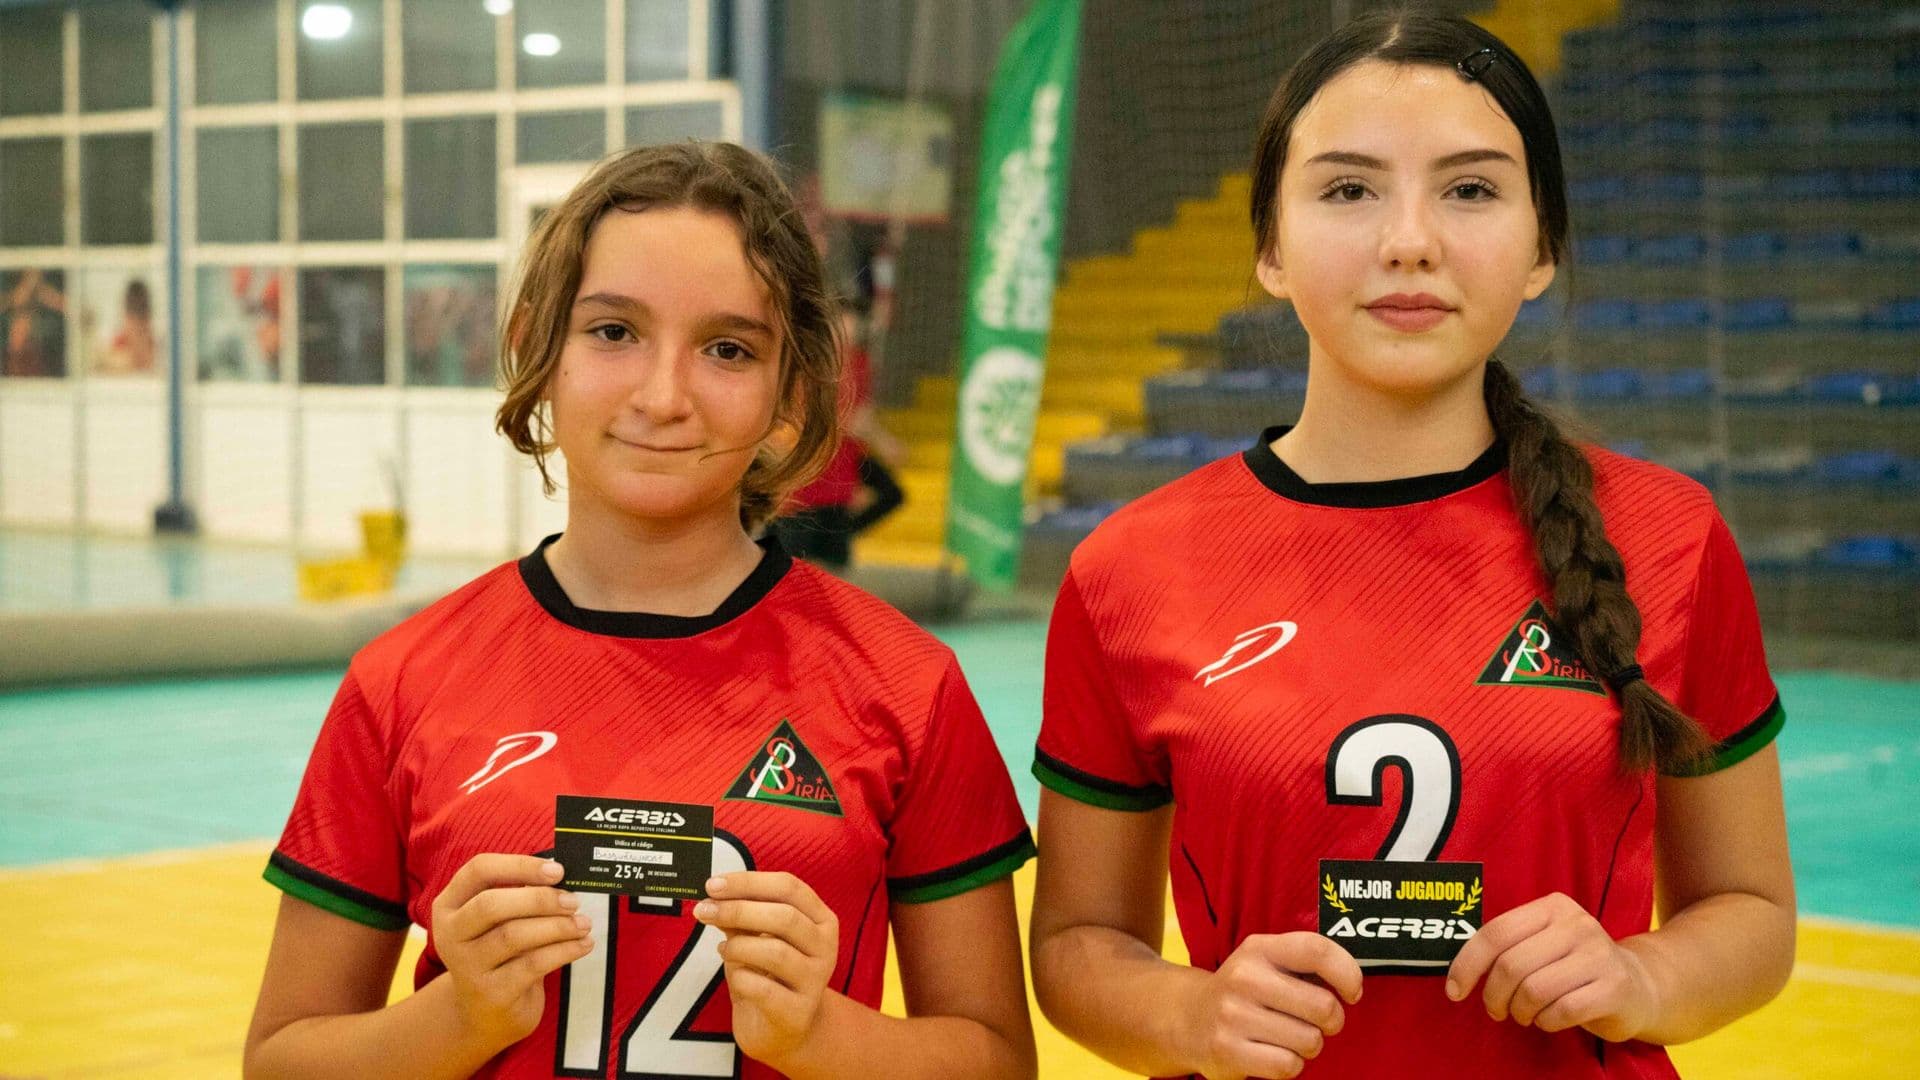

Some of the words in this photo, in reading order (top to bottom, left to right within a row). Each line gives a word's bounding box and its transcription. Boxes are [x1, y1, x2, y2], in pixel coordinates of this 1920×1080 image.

[1325, 713, 1461, 861] 2
[584, 806, 686, 827] ACERBIS
[614, 864, 645, 879] 25%
[1338, 879, 1392, 900] MEJOR
[1396, 881, 1465, 901] JUGADOR
[1326, 916, 1478, 940] ACERBIS
